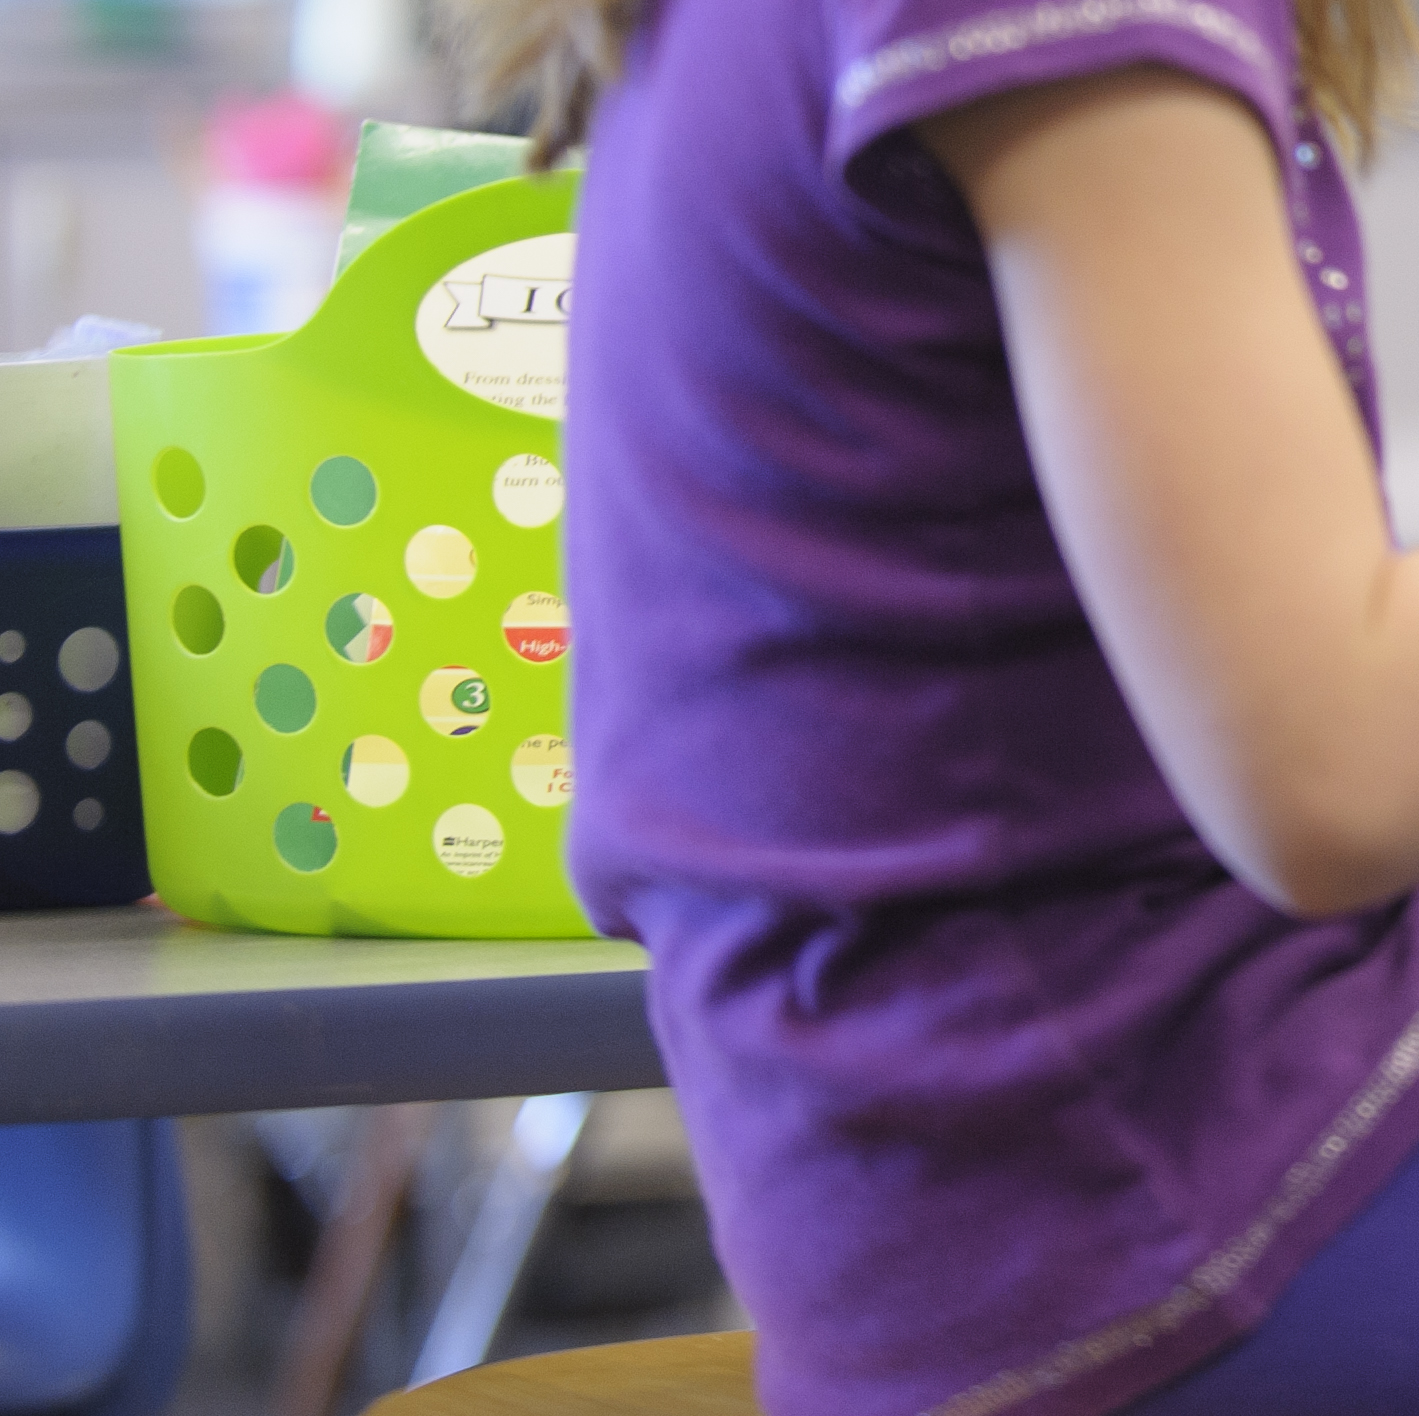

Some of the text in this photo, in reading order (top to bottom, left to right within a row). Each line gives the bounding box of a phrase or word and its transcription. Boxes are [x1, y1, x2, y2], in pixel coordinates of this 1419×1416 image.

[521, 287, 539, 314] I
[464, 371, 511, 385] From
[531, 393, 557, 405] the
[503, 477, 540, 486] turn
[462, 682, 486, 708] 3
